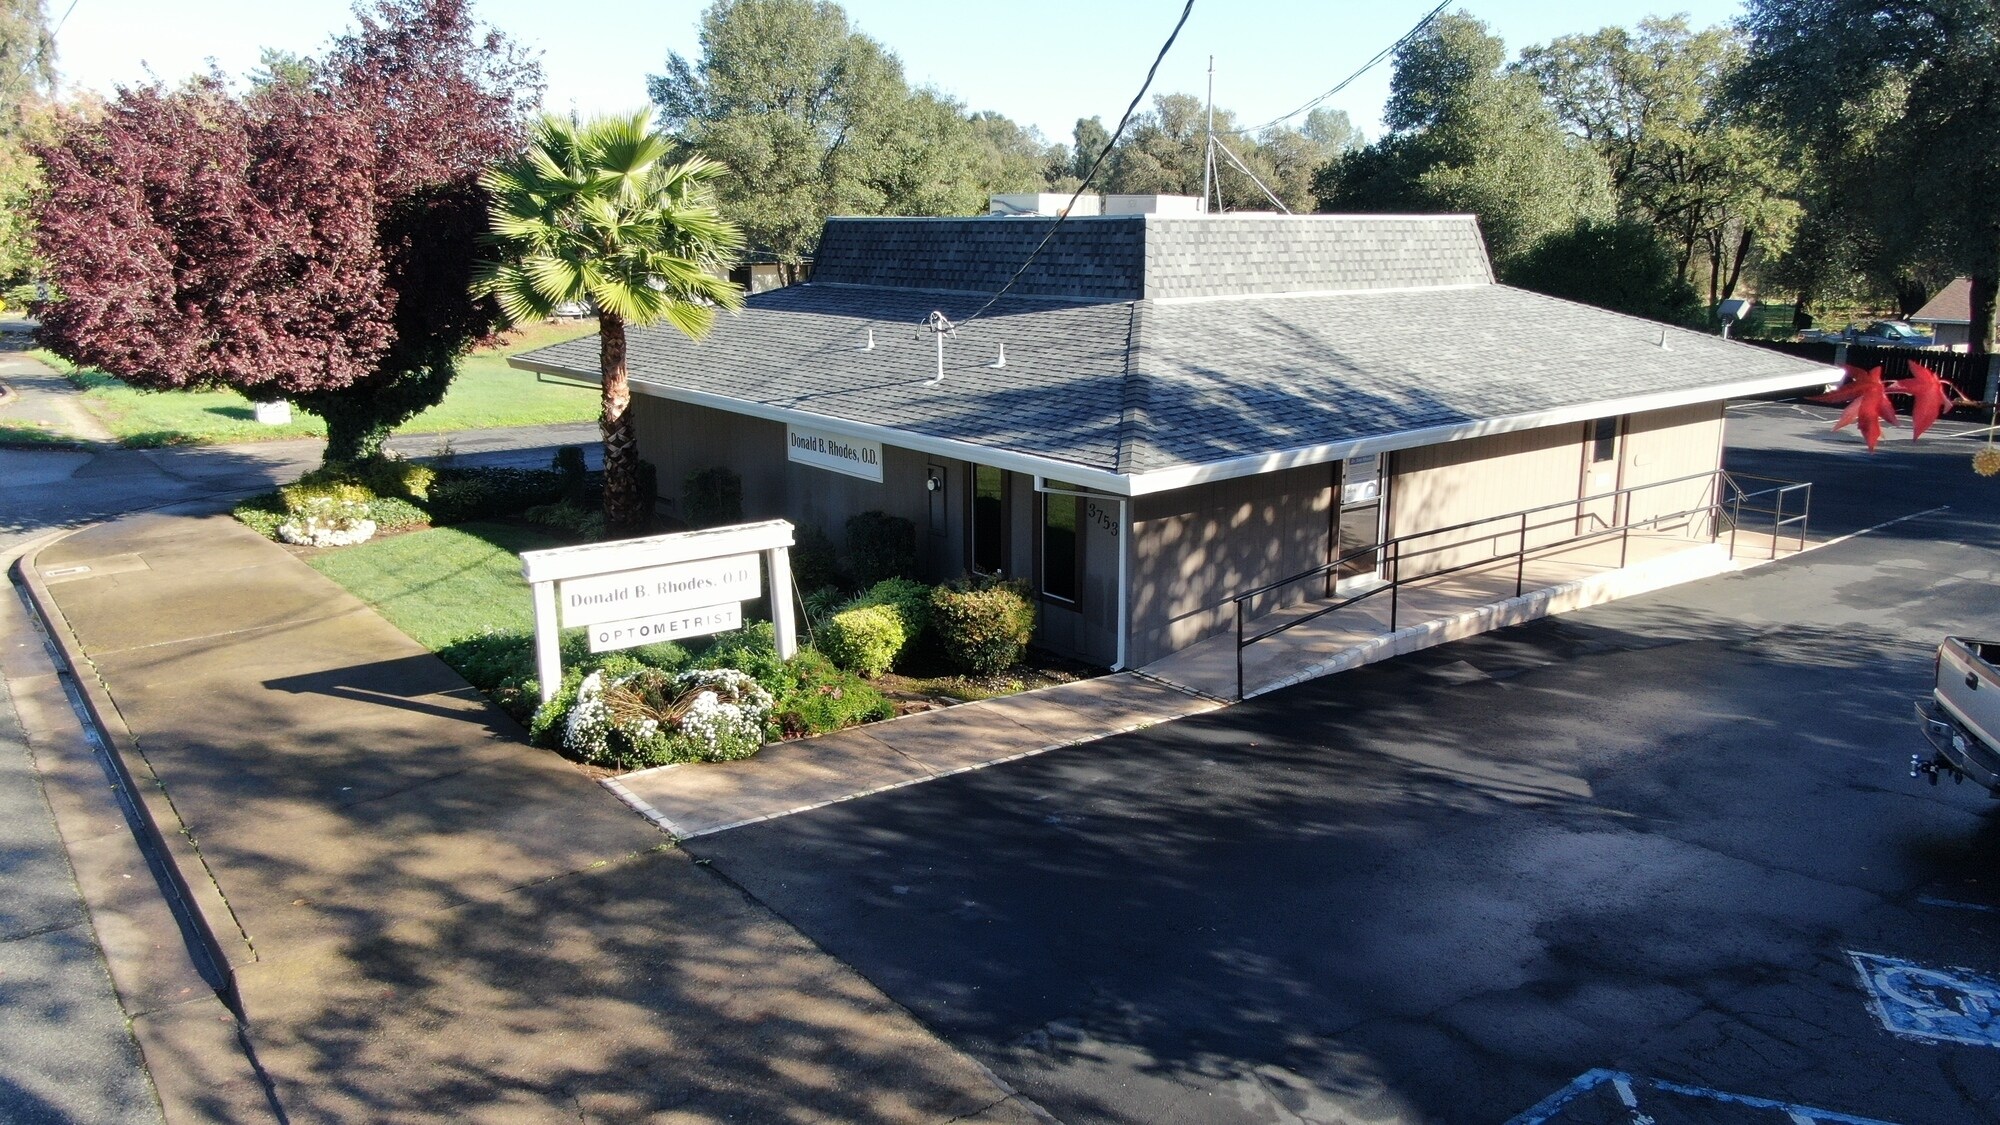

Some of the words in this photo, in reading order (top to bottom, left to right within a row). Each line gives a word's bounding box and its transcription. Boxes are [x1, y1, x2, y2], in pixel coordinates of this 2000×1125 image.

[791, 432, 817, 451] Donald
[819, 438, 827, 454] B.
[828, 440, 860, 463] Rhodes,
[862, 447, 878, 466] O.D.
[1088, 503, 1118, 536] 3753
[571, 587, 628, 607] Donald
[635, 584, 650, 599] B.
[599, 612, 733, 643] OPTOMETRIST
